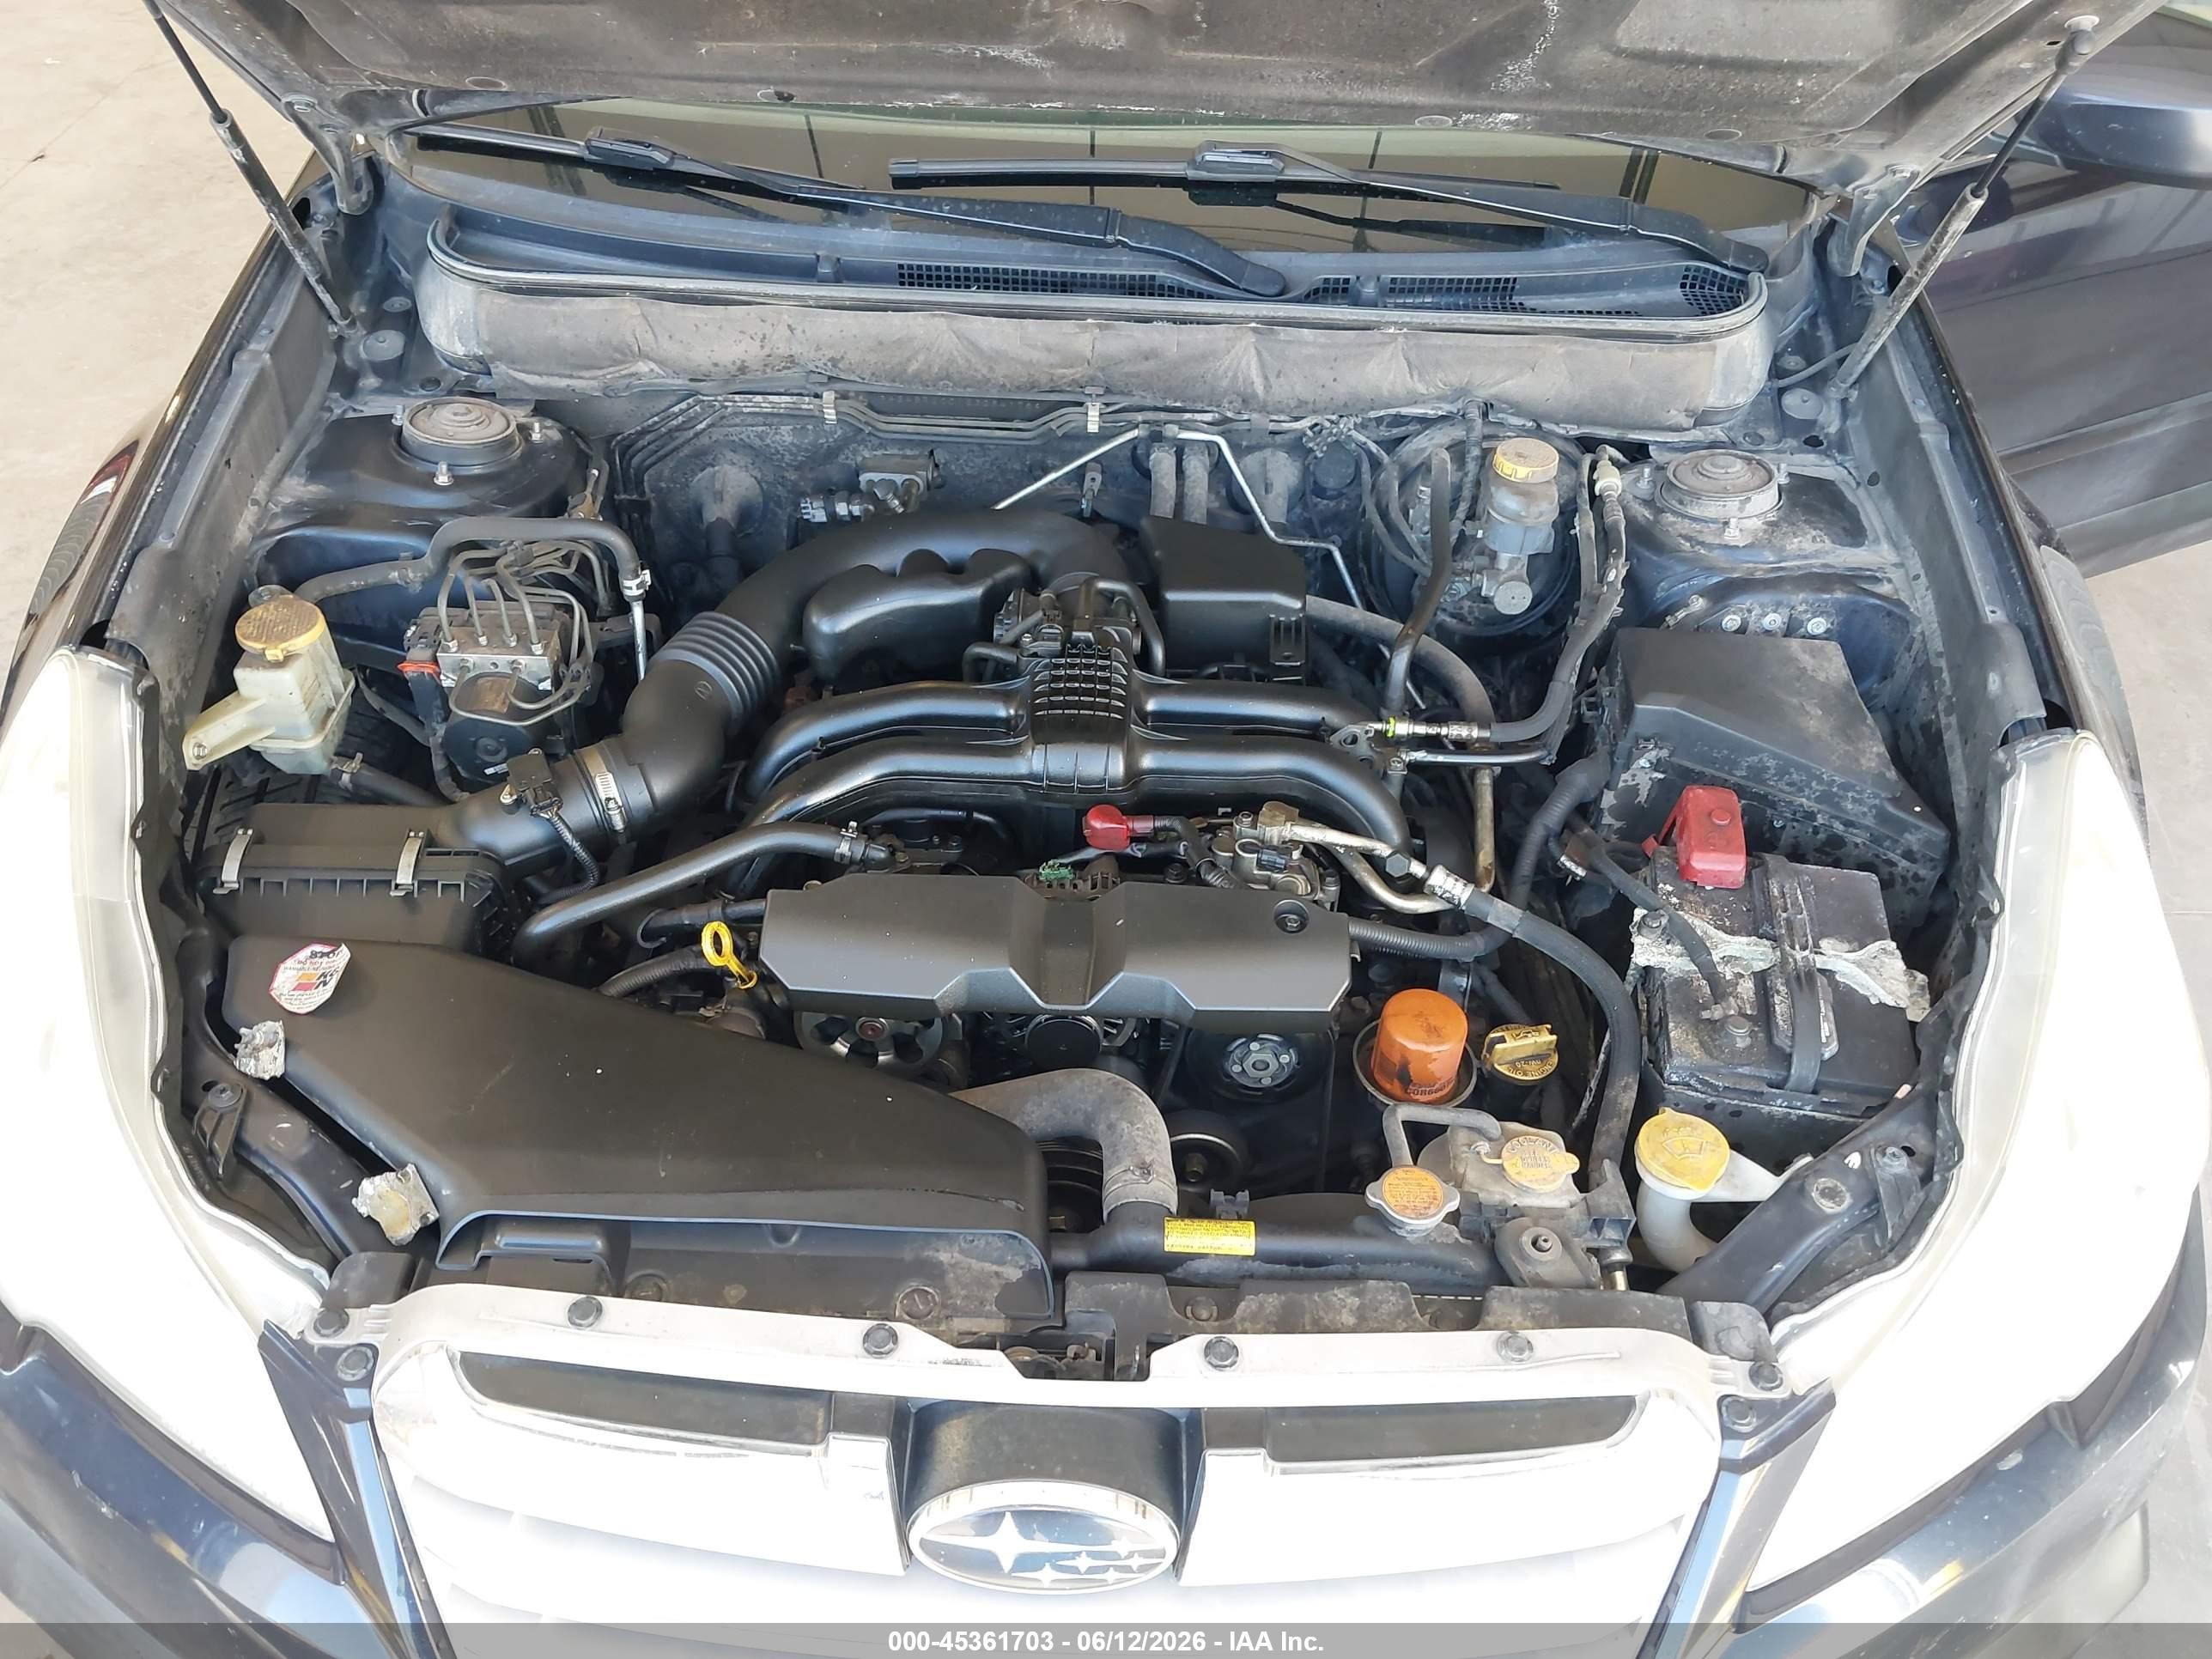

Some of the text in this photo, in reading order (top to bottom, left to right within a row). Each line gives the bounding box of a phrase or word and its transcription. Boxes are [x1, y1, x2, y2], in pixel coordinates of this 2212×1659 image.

[1508, 1060, 1554, 1078] ENGINE OIL
[1508, 1137, 1559, 1153] COOLANT
